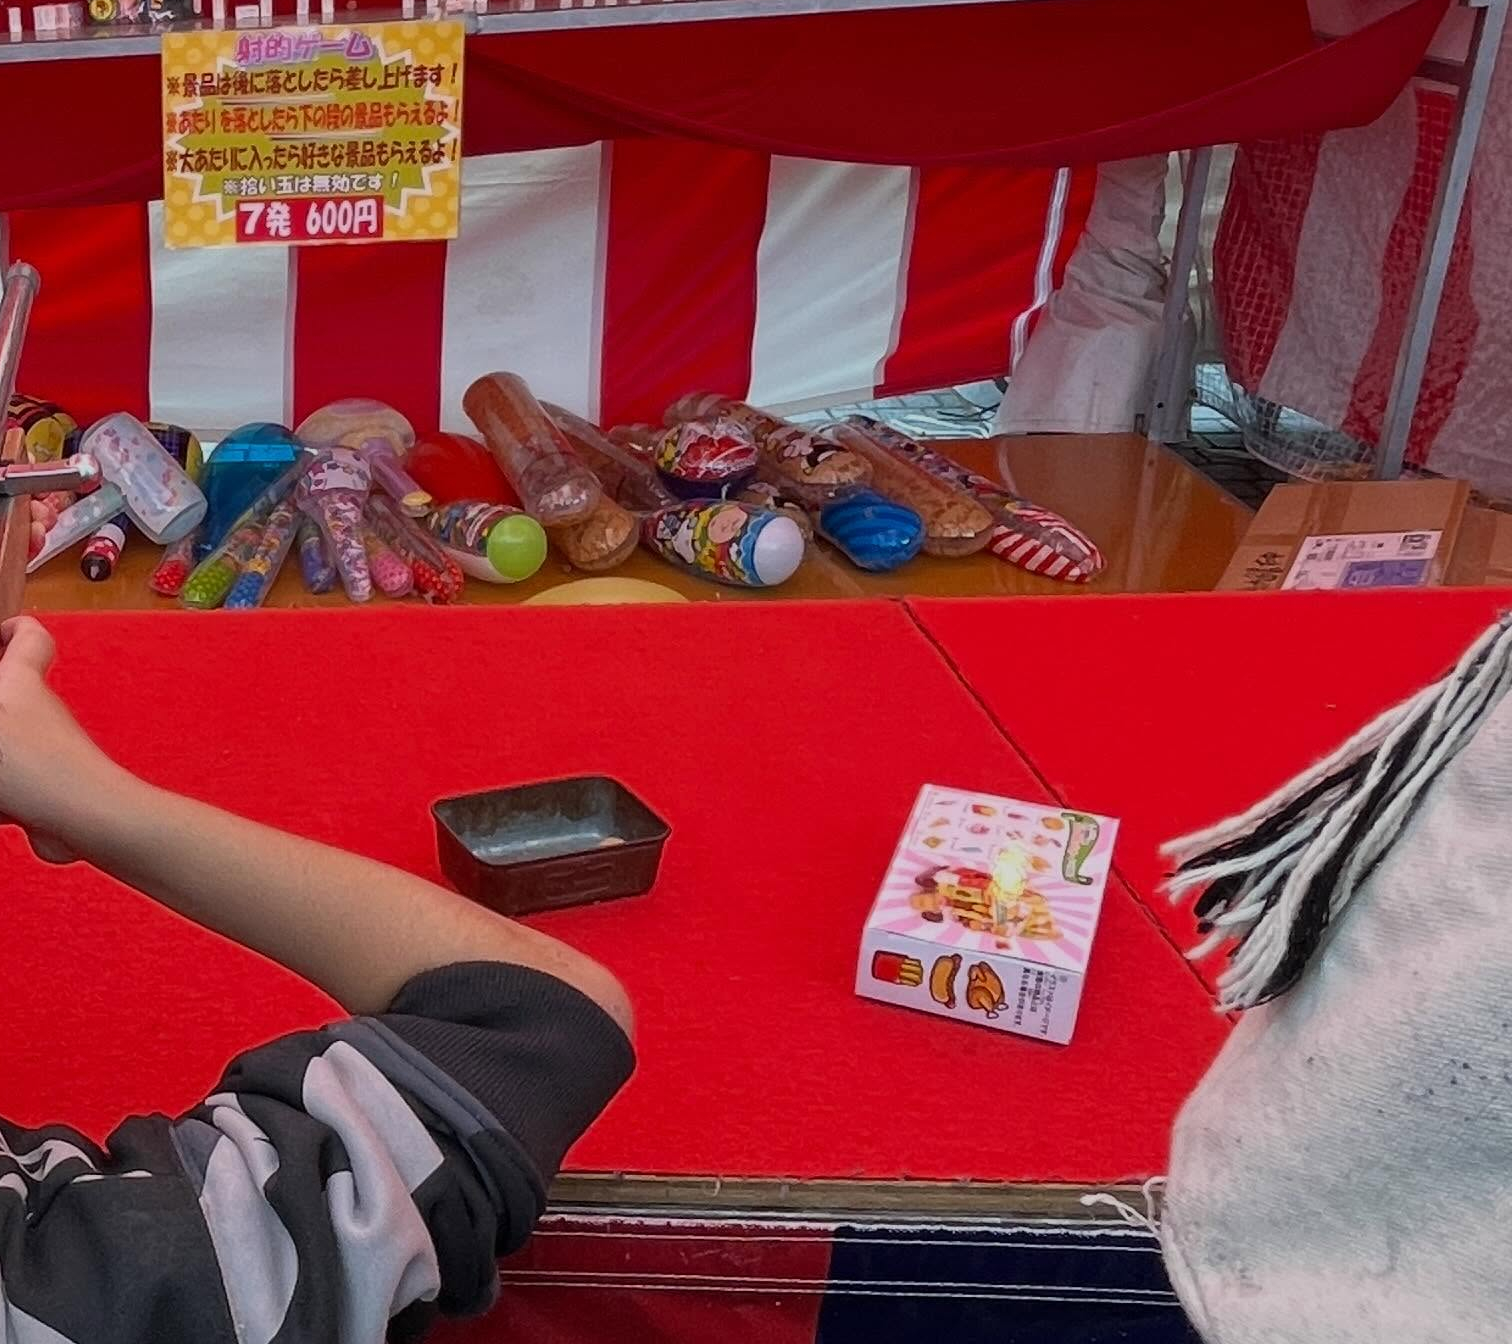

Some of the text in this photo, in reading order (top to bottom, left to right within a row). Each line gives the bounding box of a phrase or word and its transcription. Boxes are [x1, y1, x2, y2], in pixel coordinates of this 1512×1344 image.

[237, 33, 373, 63] 射的ゲーム
[306, 199, 377, 234] 600円
